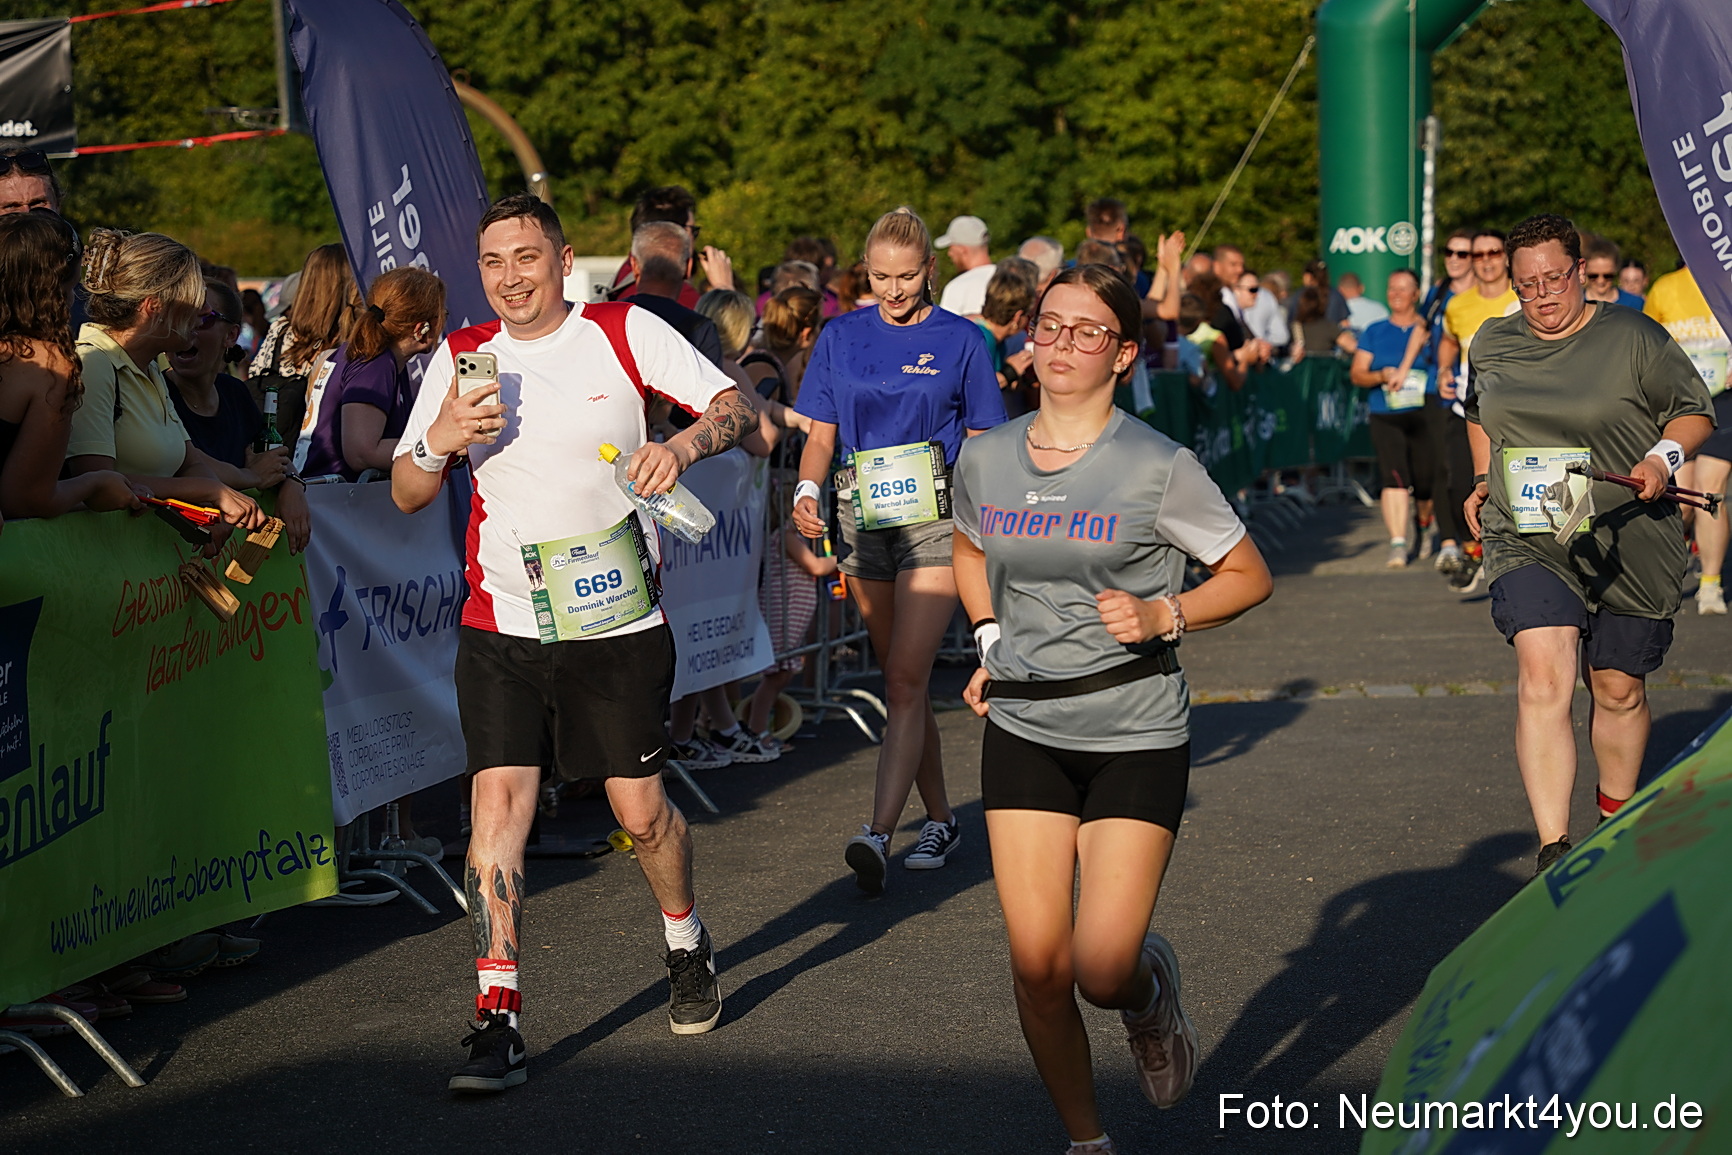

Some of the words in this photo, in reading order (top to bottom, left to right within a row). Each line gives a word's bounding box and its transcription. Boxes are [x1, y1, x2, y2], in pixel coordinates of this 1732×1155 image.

[1329, 227, 1387, 254] AOK
[901, 365, 941, 376] Tchibo
[869, 478, 917, 500] 2696
[874, 500, 902, 510] Warchol
[902, 497, 919, 506] Julia
[1511, 504, 1539, 514] Dagmar
[980, 503, 1063, 539] Tiroler
[1066, 509, 1120, 545] Hof
[567, 551, 600, 565] Firmenlauf
[574, 568, 623, 598] 669
[567, 598, 605, 614] Dominik
[605, 585, 639, 604] Warchol
[146, 616, 211, 695] laufen
[369, 710, 414, 738] LOGISTICS
[348, 737, 391, 769] CORPORATE
[390, 730, 417, 751] PRINT
[350, 761, 393, 792] CORPORATE
[392, 749, 426, 778] SIGNAGE
